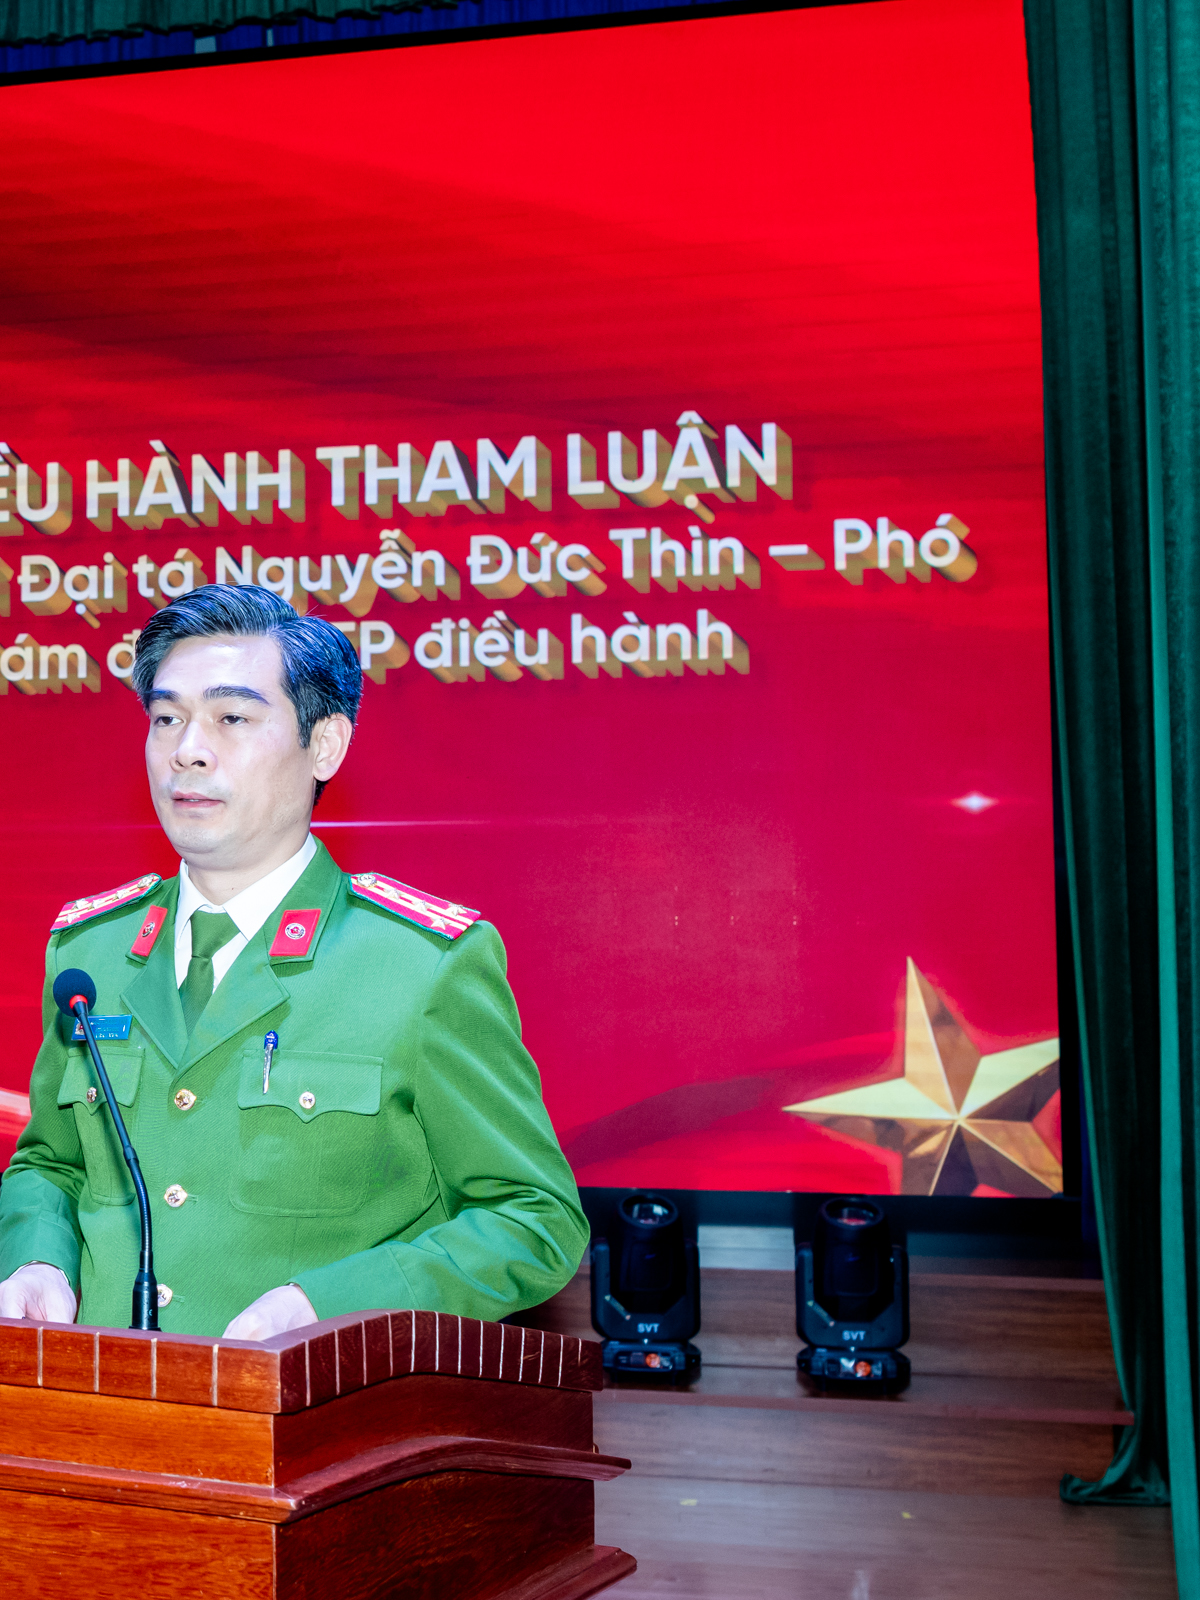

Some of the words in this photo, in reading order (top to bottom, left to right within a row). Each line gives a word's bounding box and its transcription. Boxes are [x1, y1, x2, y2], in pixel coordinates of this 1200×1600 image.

[86, 439, 292, 519] HÀNH
[315, 435, 538, 507] THAM
[566, 410, 778, 509] LUẬN
[17, 551, 115, 615] Đại
[132, 548, 194, 598] tá
[215, 528, 447, 603] Nguyễn
[466, 532, 592, 585] Đức
[608, 525, 745, 579] Thìn
[833, 513, 961, 571] Phó
[414, 610, 550, 668] điều
[571, 608, 735, 664] hành
[637, 1322, 660, 1334] SVT
[842, 1329, 866, 1341] SVT
